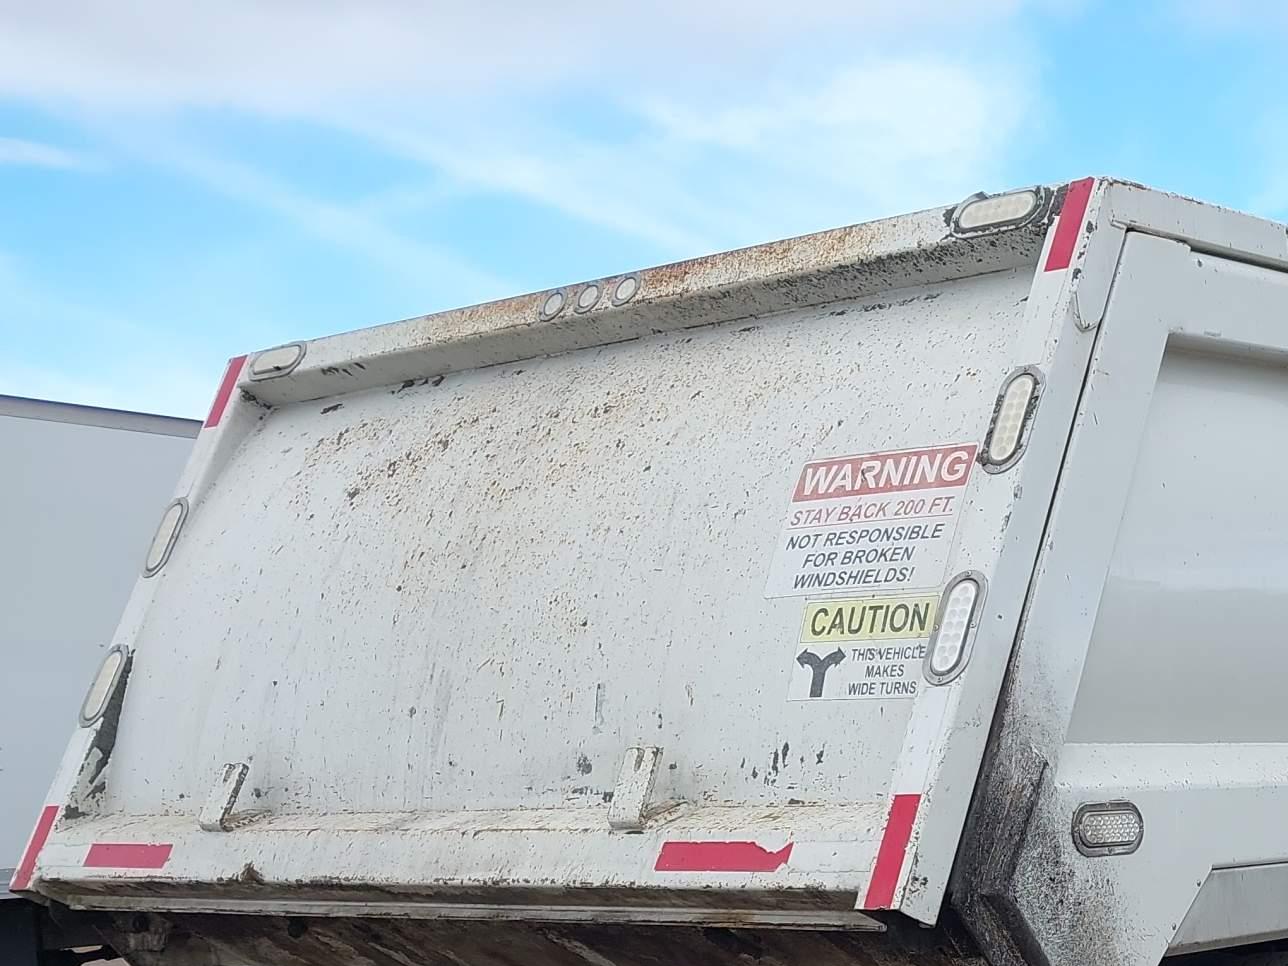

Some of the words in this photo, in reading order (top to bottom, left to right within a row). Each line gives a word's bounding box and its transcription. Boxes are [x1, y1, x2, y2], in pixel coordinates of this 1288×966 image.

[803, 450, 969, 496] WARNING
[790, 507, 837, 526] STAY
[837, 501, 890, 522] BACK
[893, 499, 926, 516] 200
[786, 533, 822, 551] NOT
[823, 523, 945, 547] RESPONSIBLE
[802, 552, 838, 568] FOR
[840, 546, 915, 566] BROKEN
[793, 567, 915, 589] WINDSHIELDS!
[810, 602, 930, 636] CAUTION
[851, 648, 876, 661] THIS
[878, 645, 926, 661] VEHICLE
[864, 664, 905, 679] MAKES
[848, 682, 877, 695] WIDE
[879, 681, 917, 695] TURNS
